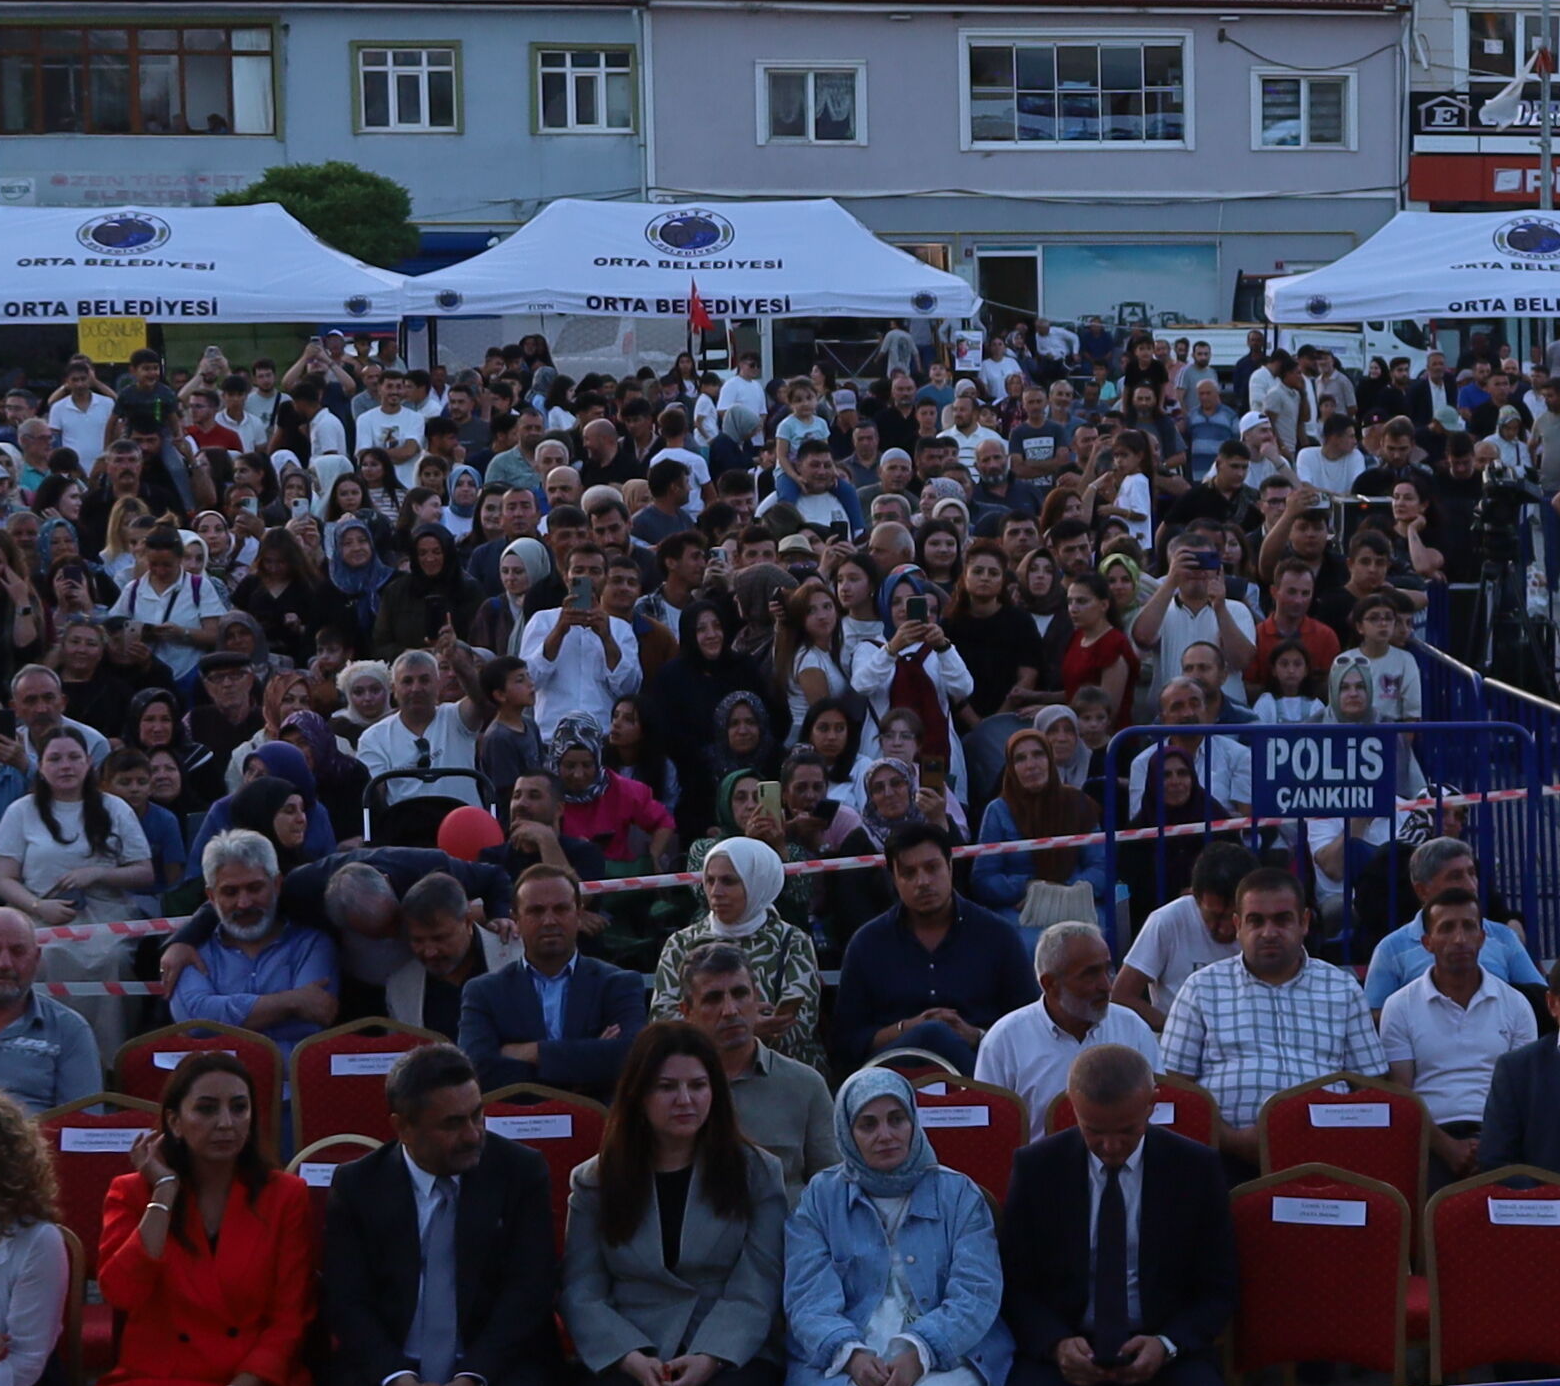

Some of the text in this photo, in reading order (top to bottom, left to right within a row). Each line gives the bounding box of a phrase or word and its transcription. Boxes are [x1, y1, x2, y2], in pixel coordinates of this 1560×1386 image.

[17, 257, 216, 271] ORTA BELEDİYESİ
[593, 257, 783, 270] ORTA BELEDİYESİ
[3, 296, 218, 317] ORTA BELEDİYESİ
[586, 295, 648, 313] ORTA
[1448, 298, 1506, 313] ORTA
[1266, 736, 1384, 782] POLİS
[1276, 786, 1374, 815] ÇANKIRI
